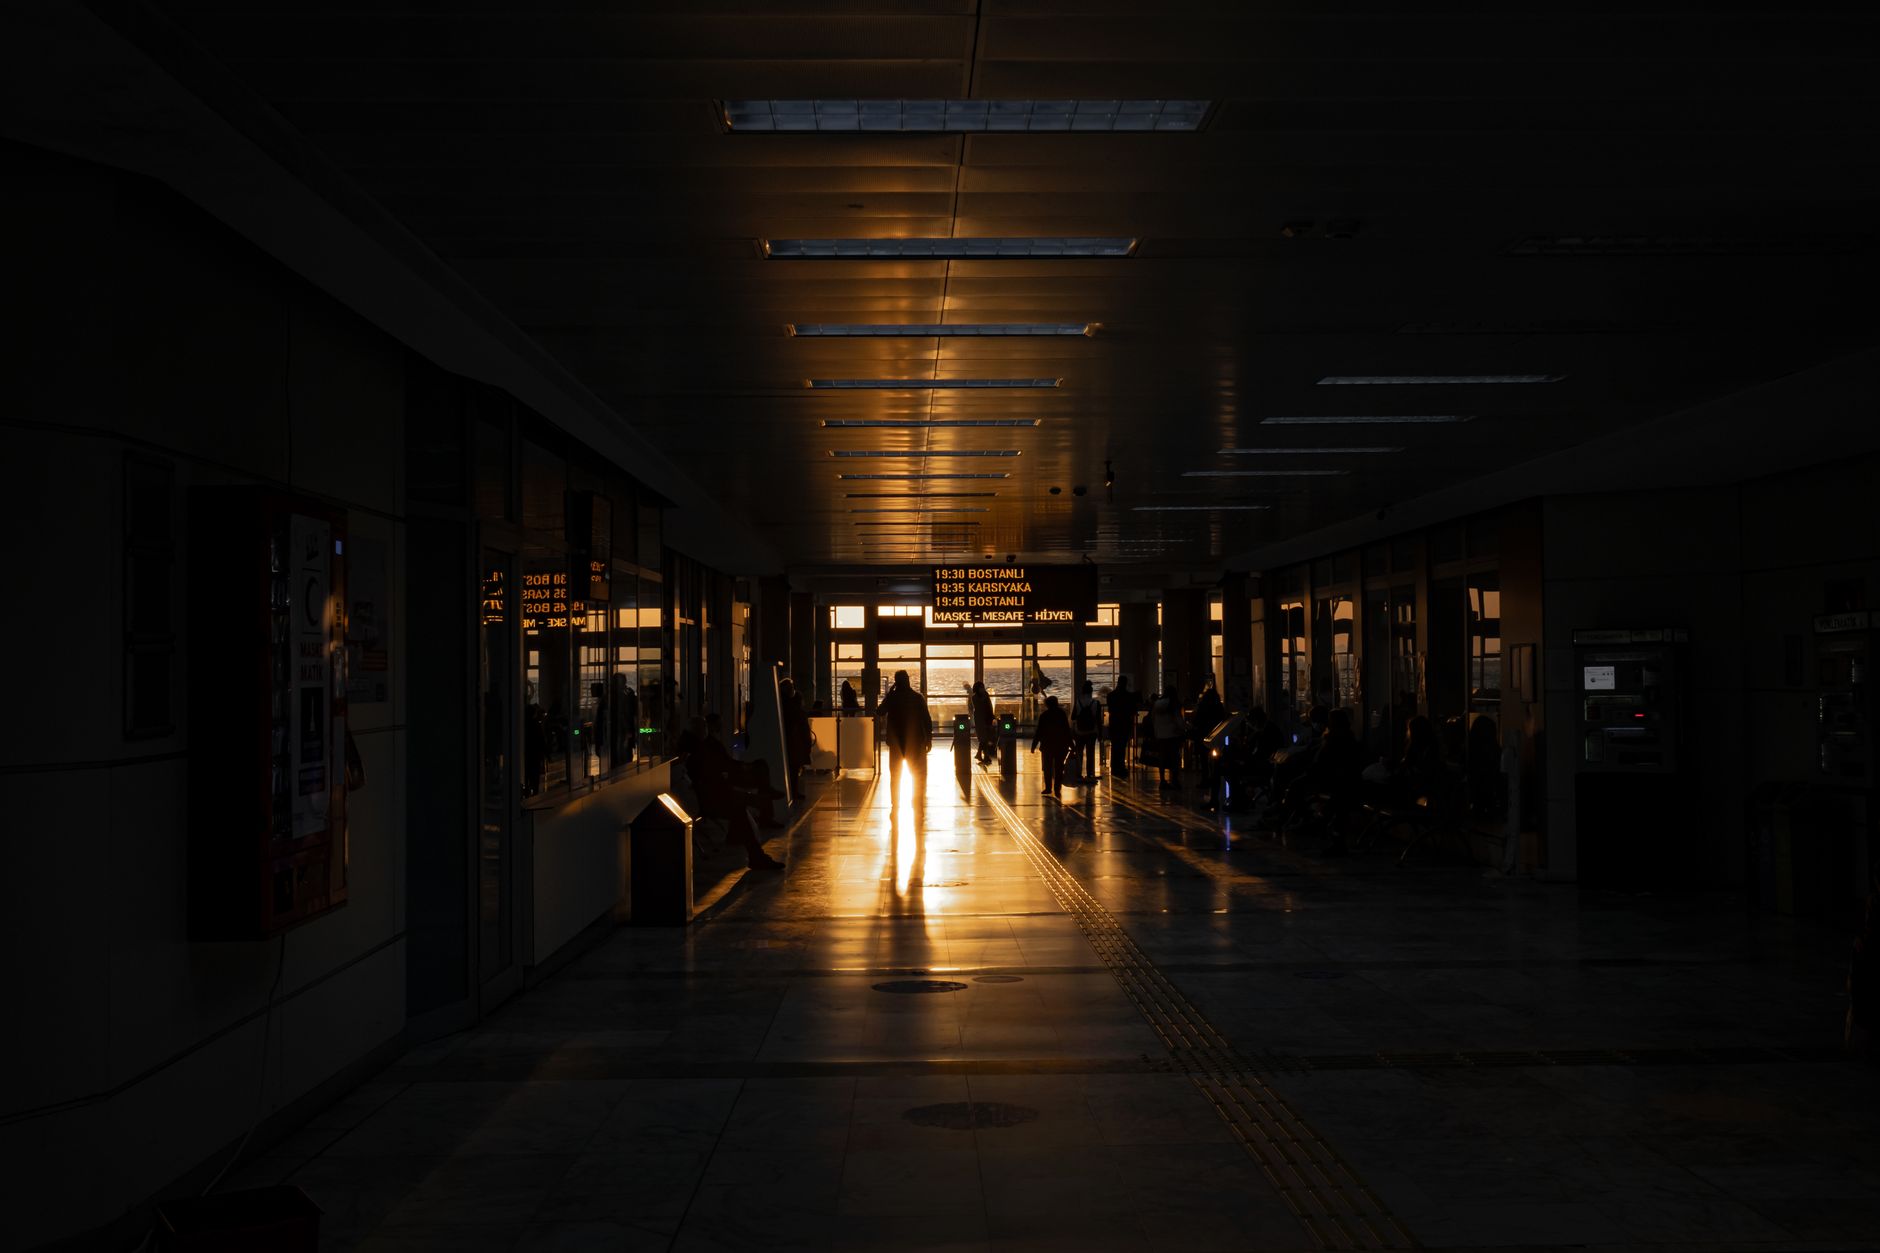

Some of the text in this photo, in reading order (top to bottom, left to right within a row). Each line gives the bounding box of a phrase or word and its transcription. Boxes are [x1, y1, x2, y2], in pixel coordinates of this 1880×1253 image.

[935, 568, 1025, 579] 19:30 BOSTANLI
[935, 582, 1032, 593] 19:35 KARSIYAKA
[935, 596, 1025, 607] 19:45 BOSTANLI
[934, 611, 972, 622] MASKE
[982, 611, 1025, 622] MESAFE
